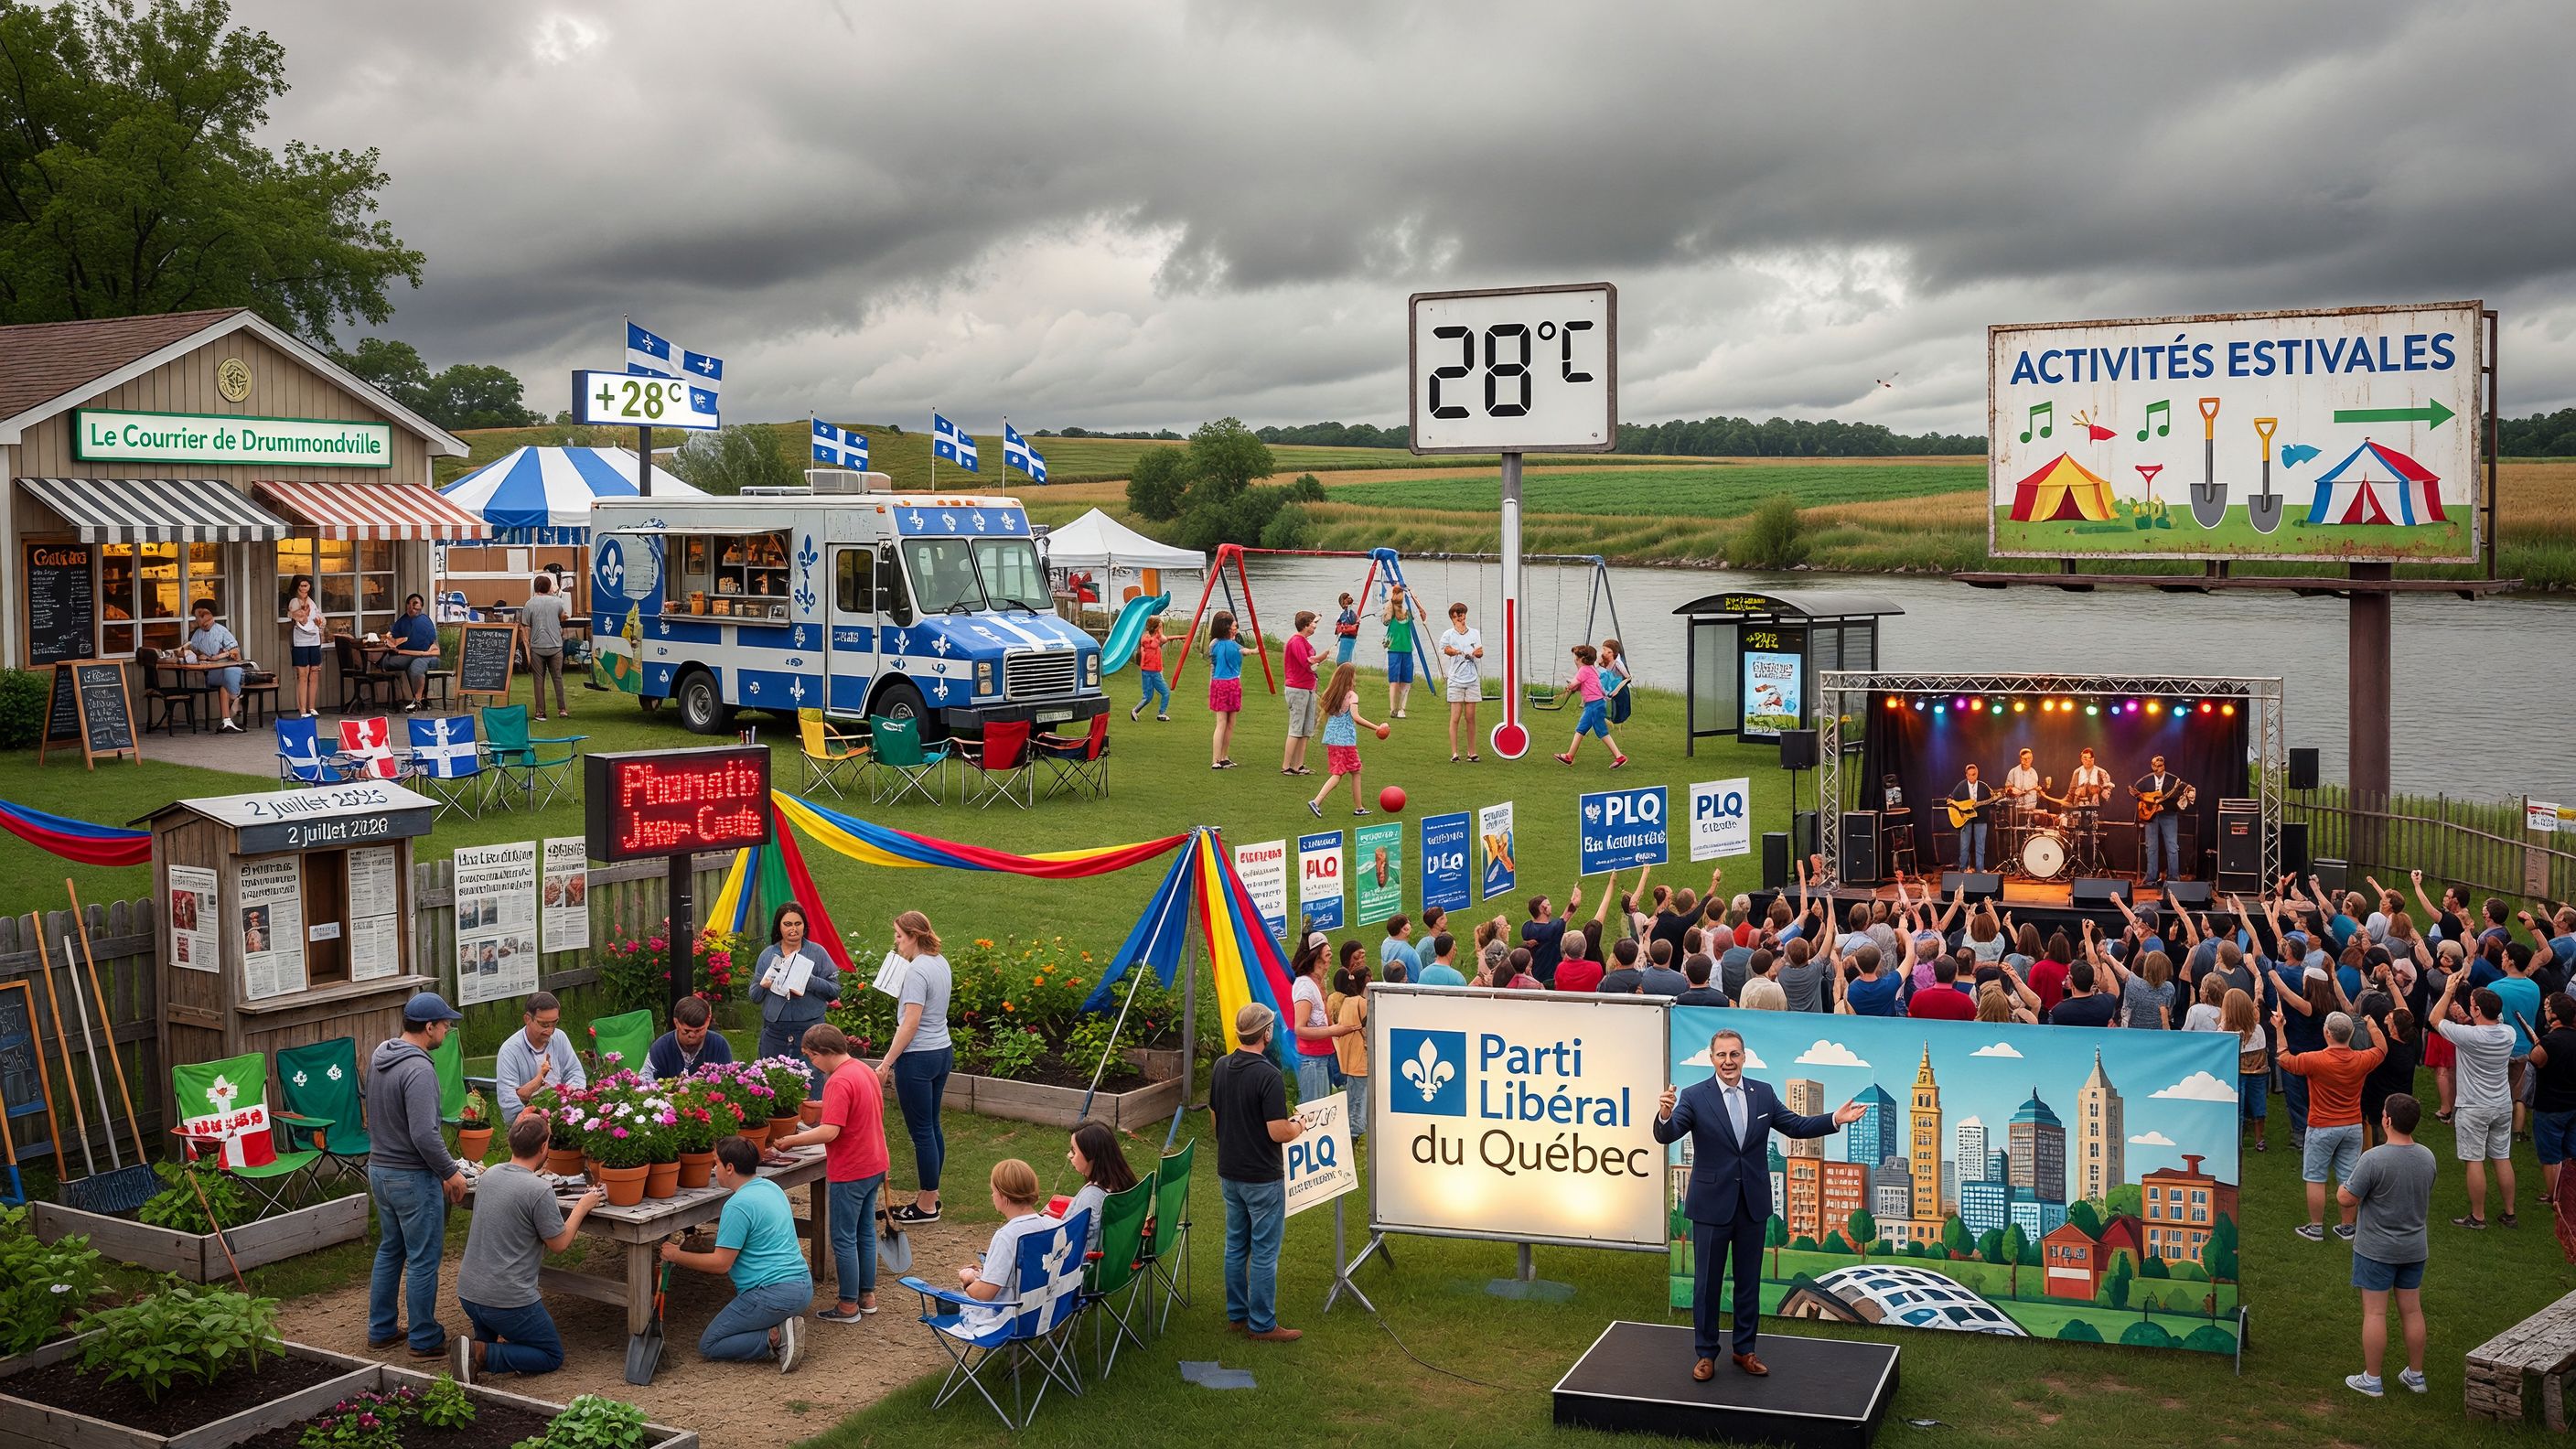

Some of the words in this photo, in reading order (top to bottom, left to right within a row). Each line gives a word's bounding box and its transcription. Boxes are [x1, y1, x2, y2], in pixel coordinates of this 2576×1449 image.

[1429, 321, 1594, 419] 28°C
[2010, 334, 2216, 385] ACTIVITÉS
[2228, 332, 2456, 377] ESTIVALES
[91, 423, 117, 446] Le
[123, 424, 209, 449] Courrier
[212, 427, 237, 450] de
[242, 429, 381, 455] Drummondville
[244, 801, 268, 816] 2
[1605, 792, 1660, 827] PLQ
[1696, 792, 1744, 821] PLQ
[287, 826, 299, 844] 2
[302, 822, 348, 847] juillet
[1480, 1033, 1582, 1078] Parti
[1480, 1079, 1630, 1127] Libéral
[1288, 1135, 1337, 1181] PLQ
[1411, 1124, 1464, 1165] du
[1479, 1129, 1649, 1178] Québec
